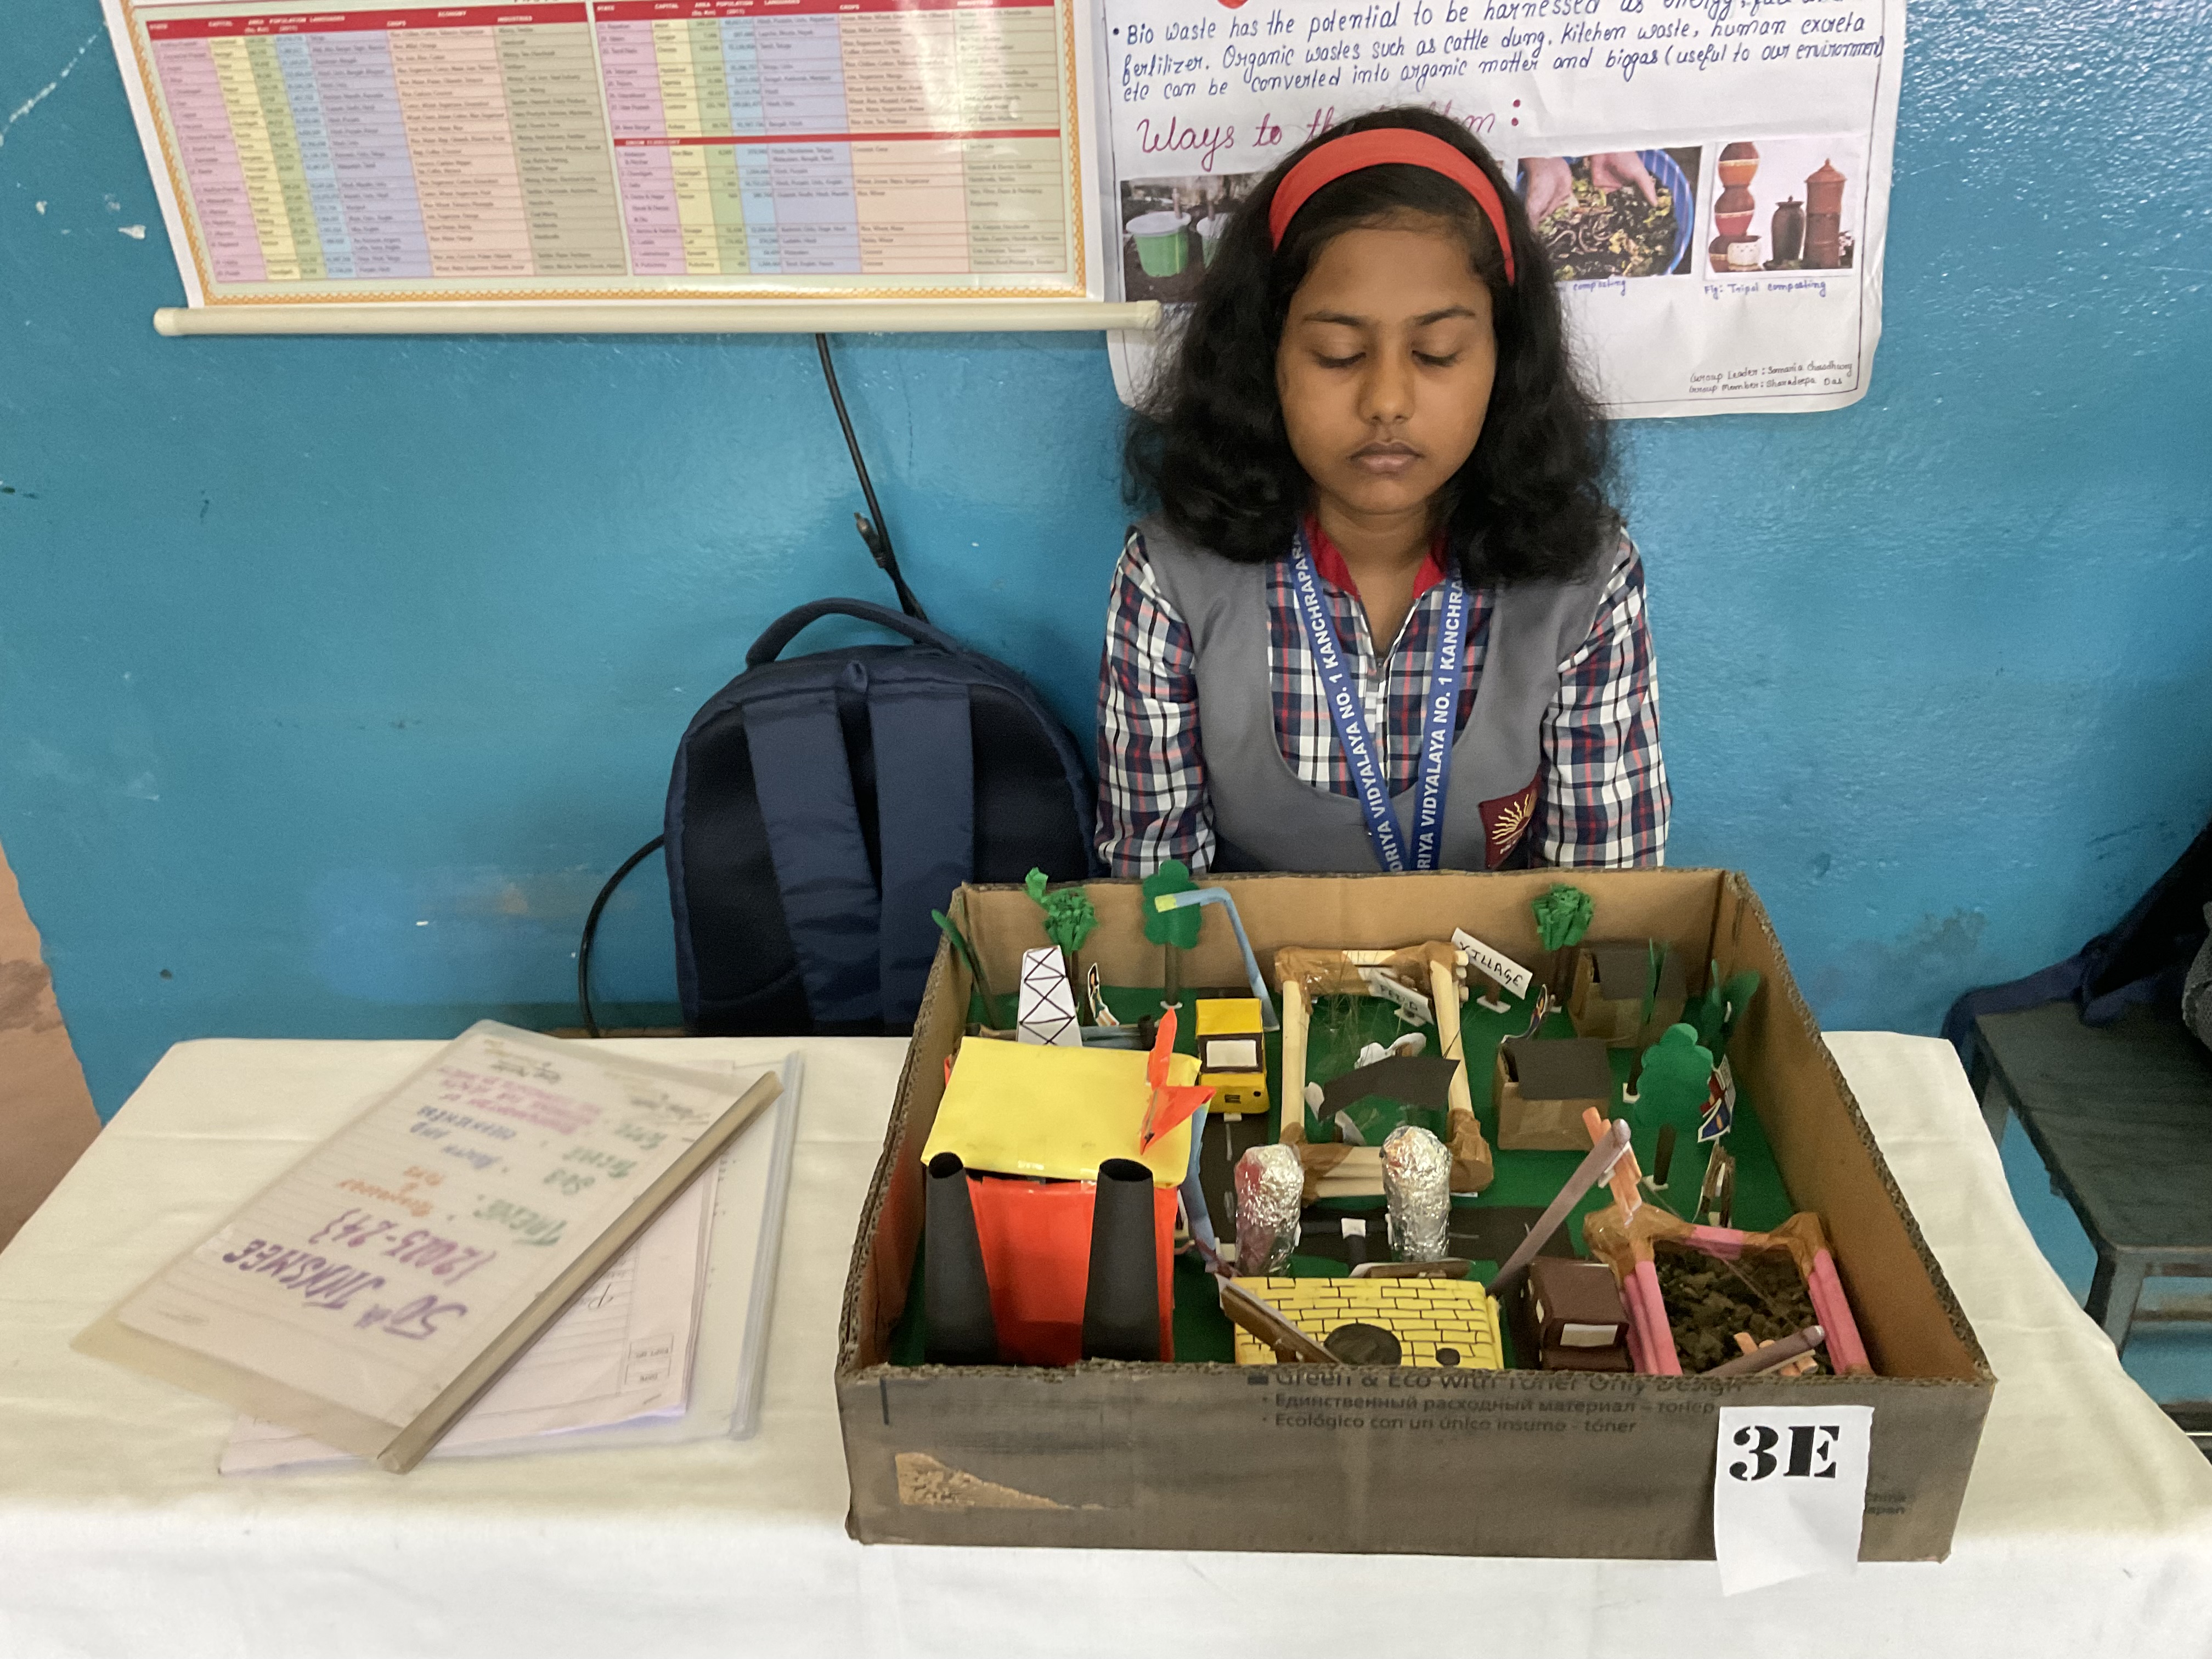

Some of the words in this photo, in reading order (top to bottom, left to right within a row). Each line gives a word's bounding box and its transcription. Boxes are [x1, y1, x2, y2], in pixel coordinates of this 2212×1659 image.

[1126, 24, 1154, 45] Bio
[1229, 15, 1258, 38] has
[1267, 9, 1295, 36] the
[1307, 2, 1400, 42] potential
[1413, 0, 1432, 25] to
[1446, 0, 1469, 22] be
[1483, 0, 1599, 20] harnessed
[1223, 44, 1294, 84] Organic
[1305, 40, 1361, 63] wastes
[1372, 36, 1404, 59] such
[1416, 38, 1436, 56] as
[1637, 18, 1699, 40] waste,
[1711, 18, 1787, 37] human
[1801, 12, 1865, 35] excreta
[1124, 82, 1149, 101] etc
[1164, 82, 1196, 100] can
[1208, 78, 1228, 95] be
[1251, 66, 1341, 93] converted
[1352, 63, 1389, 84] into
[1401, 57, 1468, 93] organic
[1479, 50, 1539, 74] matter
[1553, 46, 1594, 70] and
[1732, 42, 1751, 62] to
[1761, 43, 1791, 61] our
[1136, 115, 1235, 172] Ways
[1252, 112, 1283, 147] to
[1329, 674, 1343, 685] 1
[1336, 686, 1356, 719] NO.
[1438, 677, 1453, 685] 1
[1433, 691, 1451, 723] NO.
[1345, 721, 1386, 819] VIDYALAYA
[1420, 728, 1446, 827] VIDYALAYA
[1459, 941, 1523, 988] VILLAGE
[1729, 1425, 1840, 1481] 3E
